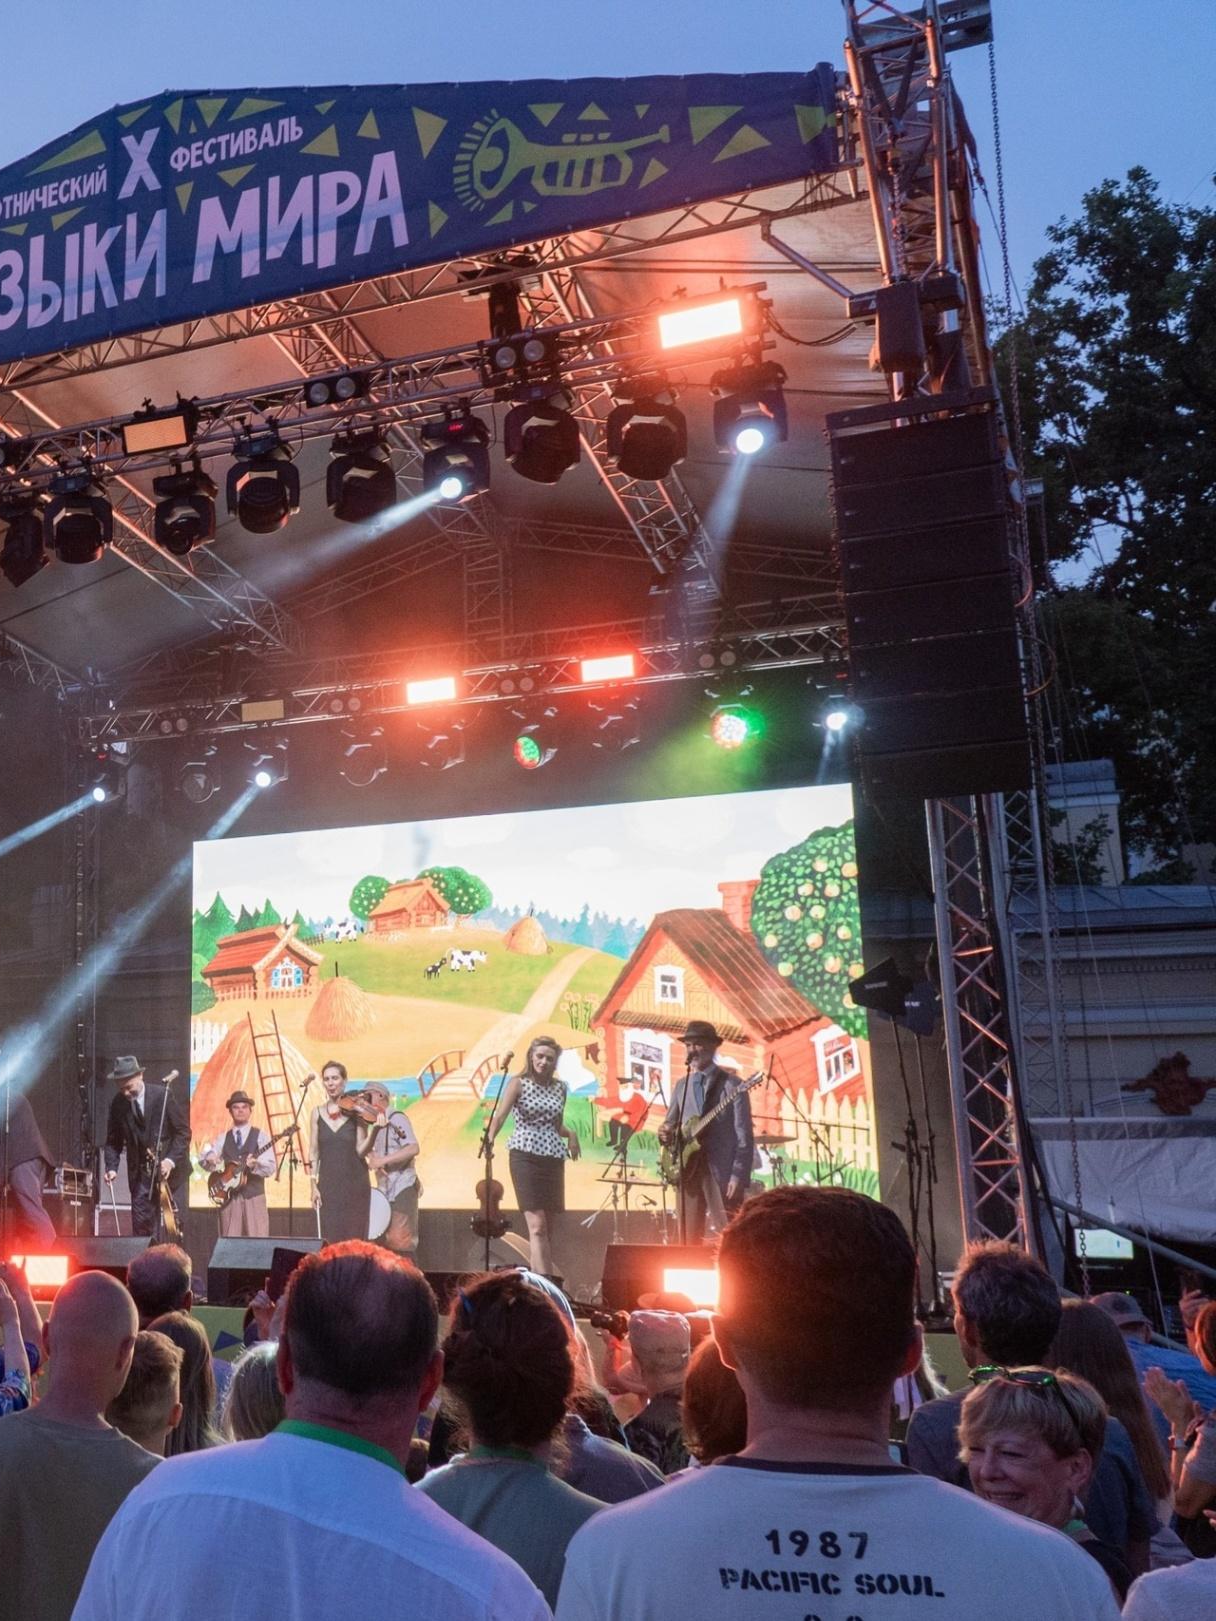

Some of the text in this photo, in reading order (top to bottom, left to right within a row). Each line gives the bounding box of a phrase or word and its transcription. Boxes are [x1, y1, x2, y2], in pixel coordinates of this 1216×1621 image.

[170, 116, 303, 172] ФЕСТИВАЛЬ
[192, 151, 408, 284] МИРА
[765, 1529, 868, 1559] 1987
[719, 1568, 945, 1598] PACIFIC SOUL
